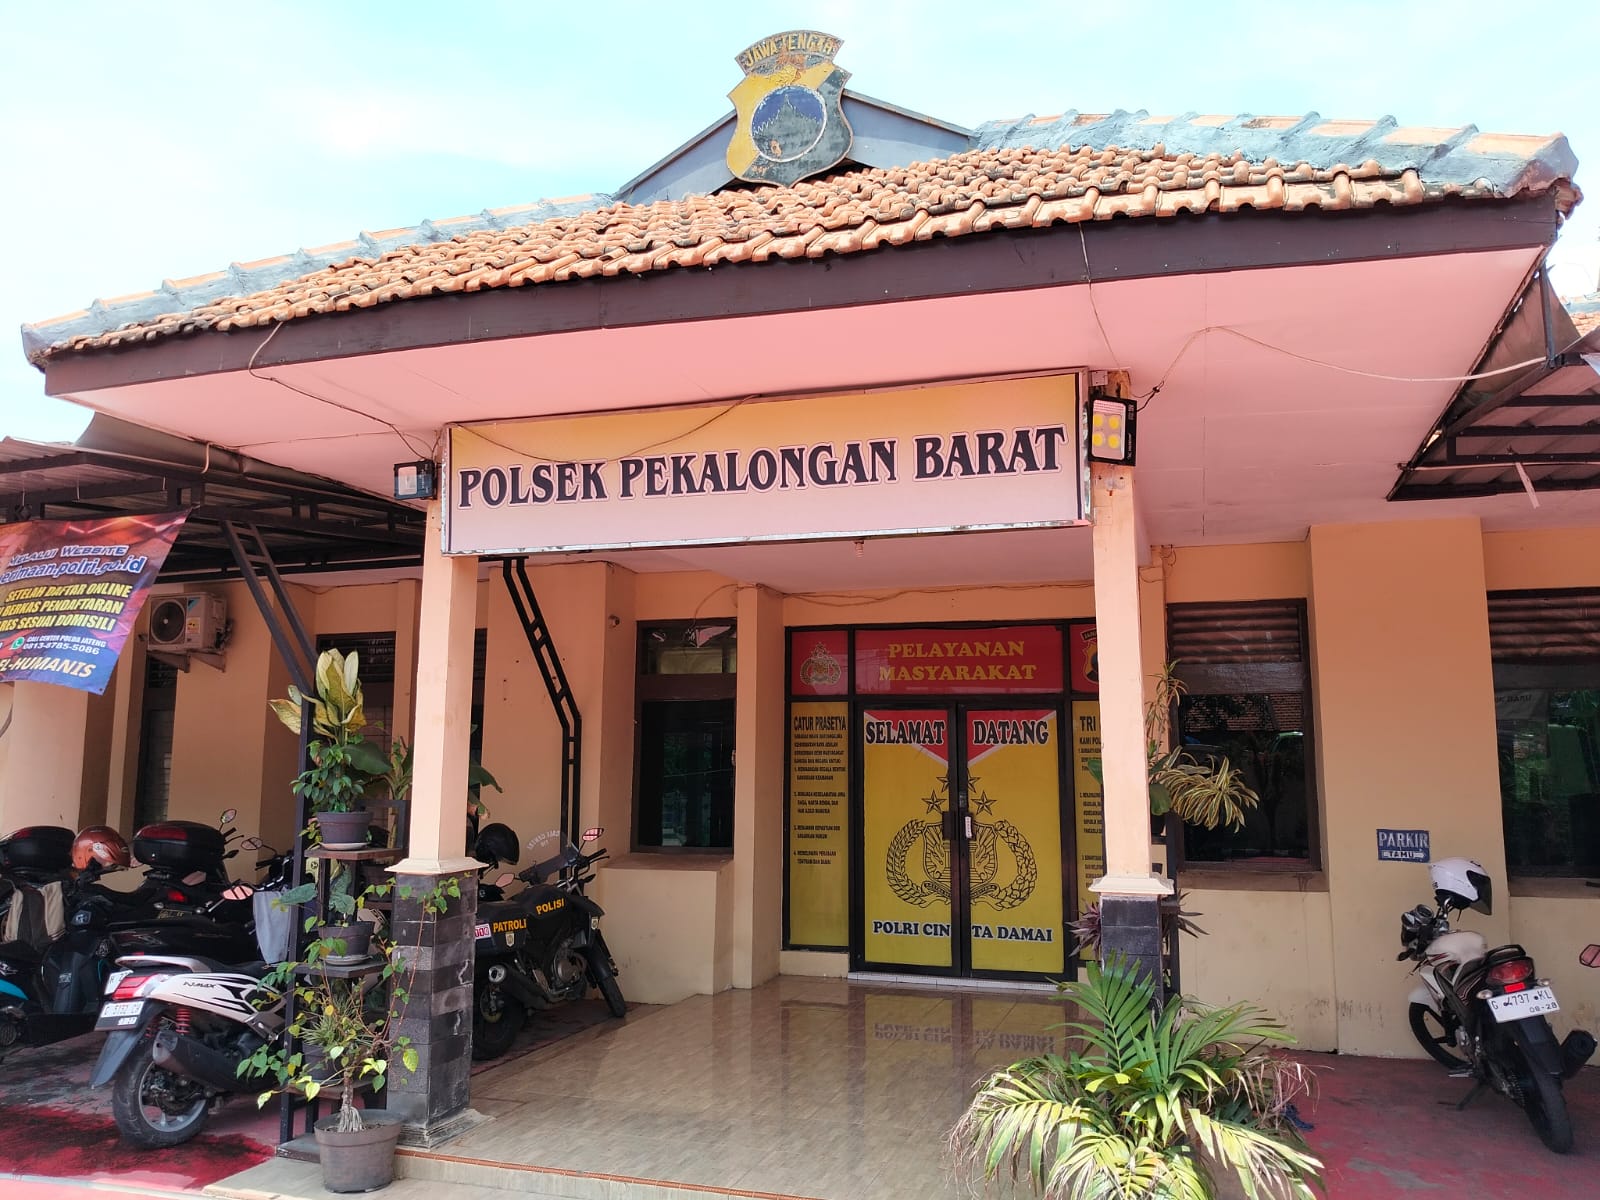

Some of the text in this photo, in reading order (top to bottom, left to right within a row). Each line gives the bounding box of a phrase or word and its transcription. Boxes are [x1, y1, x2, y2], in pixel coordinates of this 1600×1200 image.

[746, 41, 779, 66] JAWA
[458, 461, 608, 508] POLSEK
[620, 440, 897, 498] PEKALONGAN
[914, 427, 1066, 479] BARAT
[61, 545, 129, 557] WEBSITE
[6, 583, 133, 602] SETELAH DAFTAR ONLINE
[2, 598, 125, 617] BERKAS PENDAFTARAN
[18, 615, 57, 630] SESUAI
[55, 614, 117, 632] DOMISILI
[60, 635, 81, 643] POLDA
[80, 637, 107, 648] JATENG
[888, 640, 1025, 658] PELAYANAN
[879, 664, 1037, 681] MASYARAKAT
[793, 716, 847, 731] CATUR PRASETYA
[864, 719, 1049, 745] SELAMAT DATANG
[1079, 716, 1096, 732] TRI
[1378, 831, 1429, 848] PARKIR
[1389, 850, 1414, 858] TAMU
[535, 898, 565, 915] POLISI
[492, 918, 527, 933] PATROLI
[872, 920, 919, 936] POLRI
[996, 926, 1053, 942] DAMAI
[1491, 1000, 1499, 1010] G
